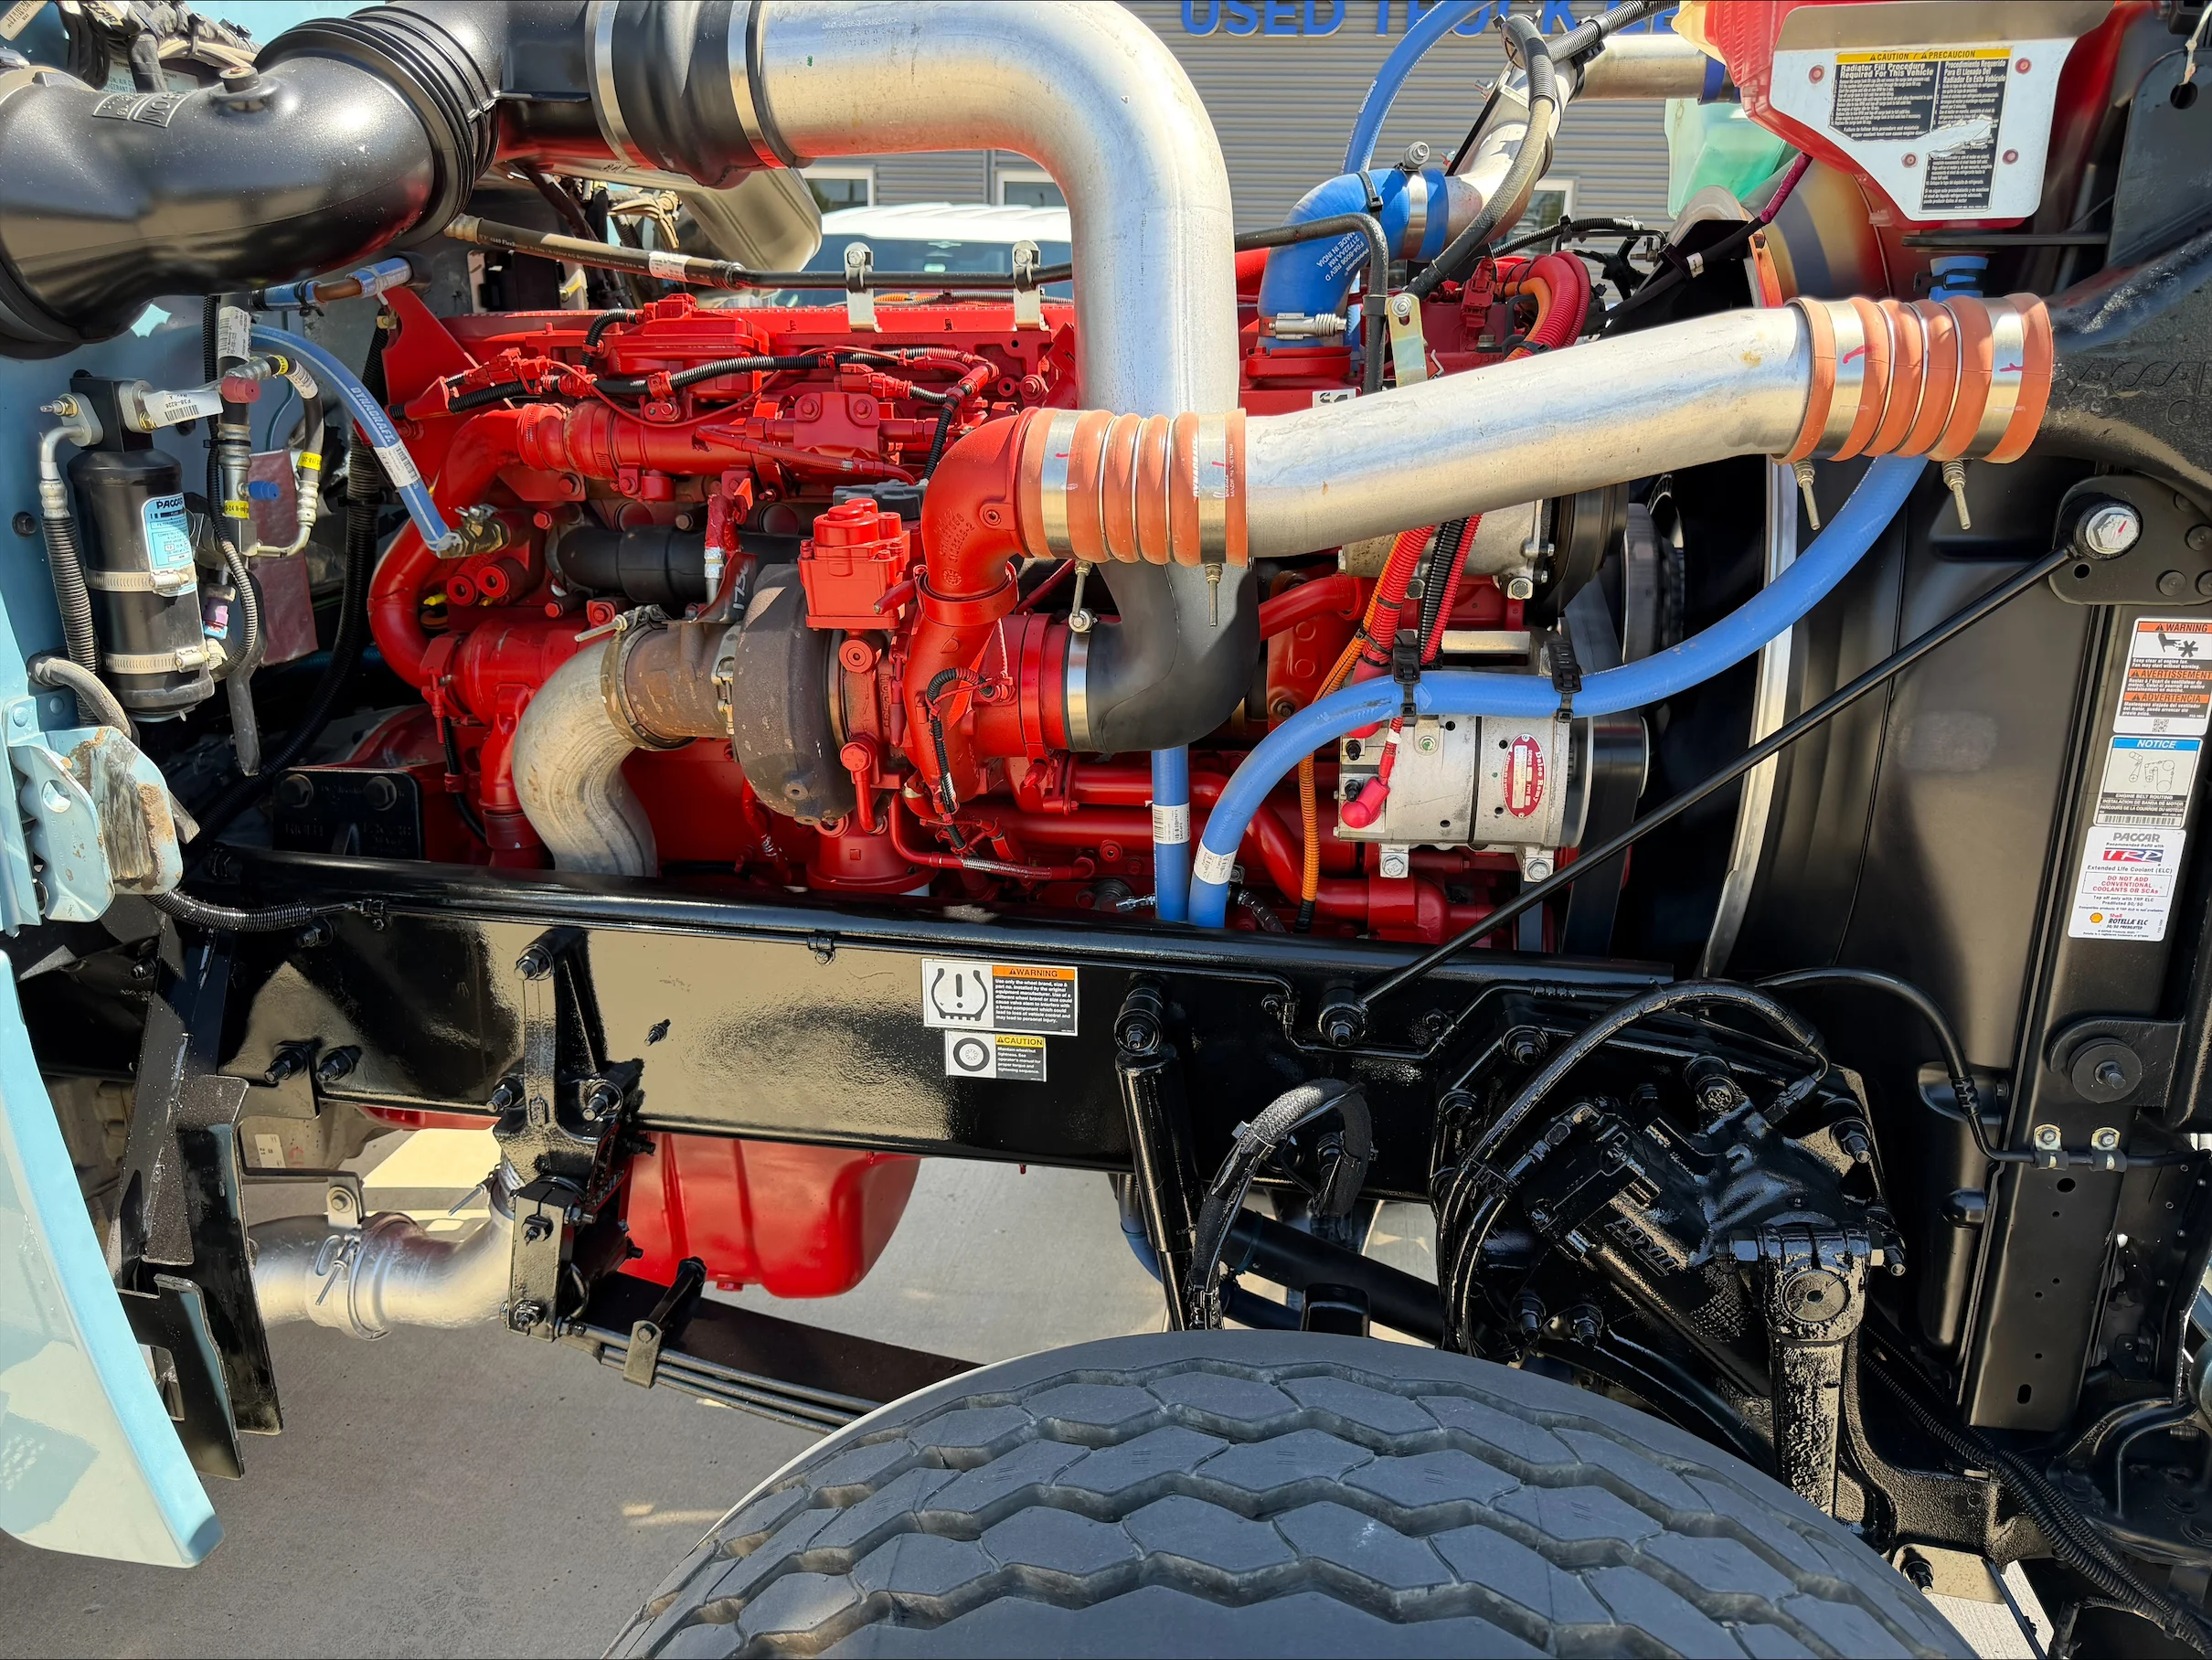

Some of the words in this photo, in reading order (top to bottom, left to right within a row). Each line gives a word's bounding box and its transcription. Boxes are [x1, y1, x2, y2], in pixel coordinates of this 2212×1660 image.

[1181, 0, 1346, 37] USED
[1929, 50, 1975, 59] PRECAUCION
[1332, 246, 1339, 254] IN
[1316, 251, 1333, 267] INDIA
[1330, 263, 1342, 276] REV
[2142, 670, 2212, 678] AVERTISSEMENT
[2142, 694, 2201, 702] ADVERTENCIA
[2137, 740, 2176, 748] NOTICE
[1536, 751, 1544, 776] Delco
[1533, 780, 1543, 803] Remy
[2113, 833, 2160, 842] PACCAR
[2105, 849, 2162, 861] TRP
[1016, 969, 1058, 977] WARNING
